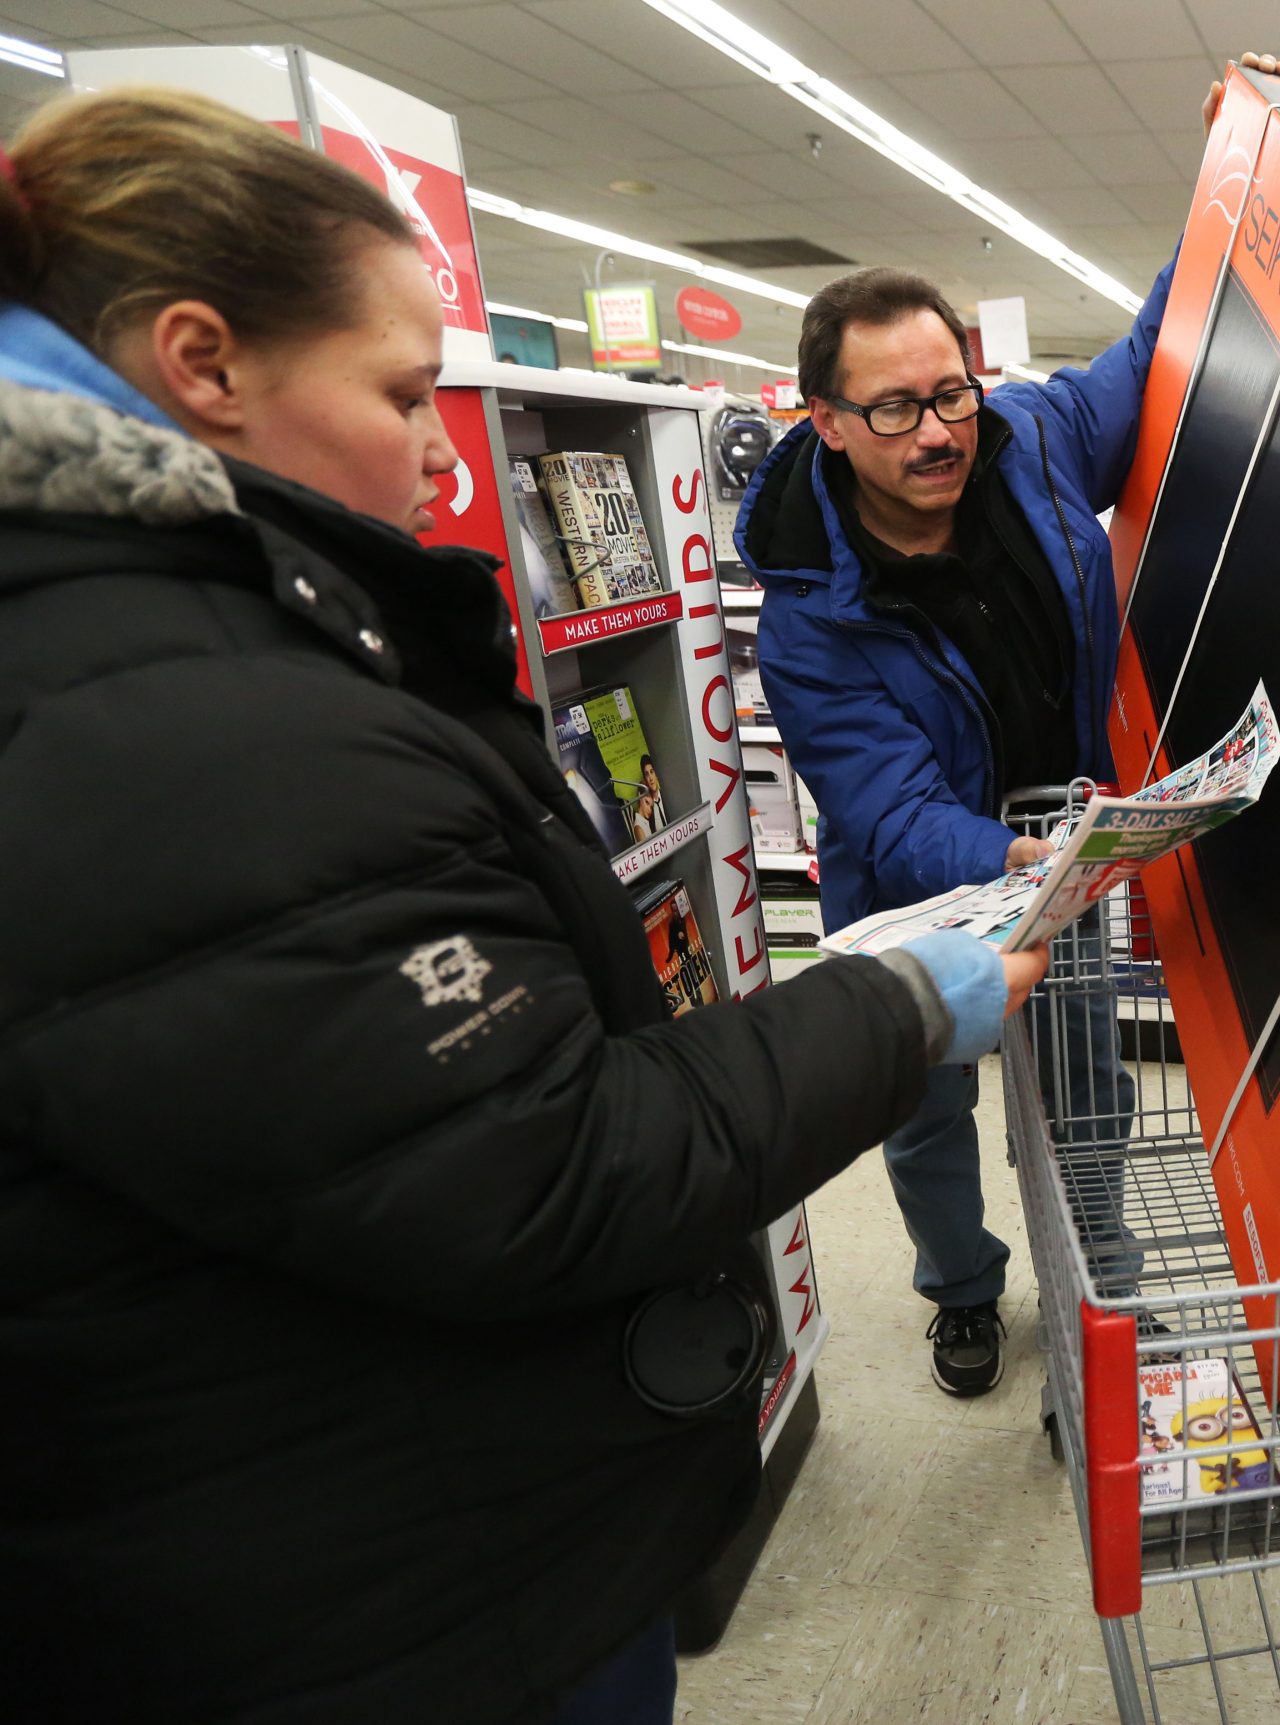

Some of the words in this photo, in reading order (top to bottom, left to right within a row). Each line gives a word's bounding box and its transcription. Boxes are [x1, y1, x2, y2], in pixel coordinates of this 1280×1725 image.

[594, 492, 631, 536] 20
[607, 536, 638, 554] MOVIE
[565, 619, 599, 641] MAKE
[601, 612, 633, 632] THEM
[634, 603, 668, 624] YOURS
[592, 713, 616, 731] perks
[1105, 810, 1161, 829] 3-DAY
[1160, 809, 1201, 828] SALE
[639, 839, 669, 865] THEM
[669, 818, 699, 847] YOURS
[1245, 1209, 1268, 1284] SE50FY2
[764, 1375, 788, 1417] YOURS
[1144, 1381, 1176, 1397] ME
